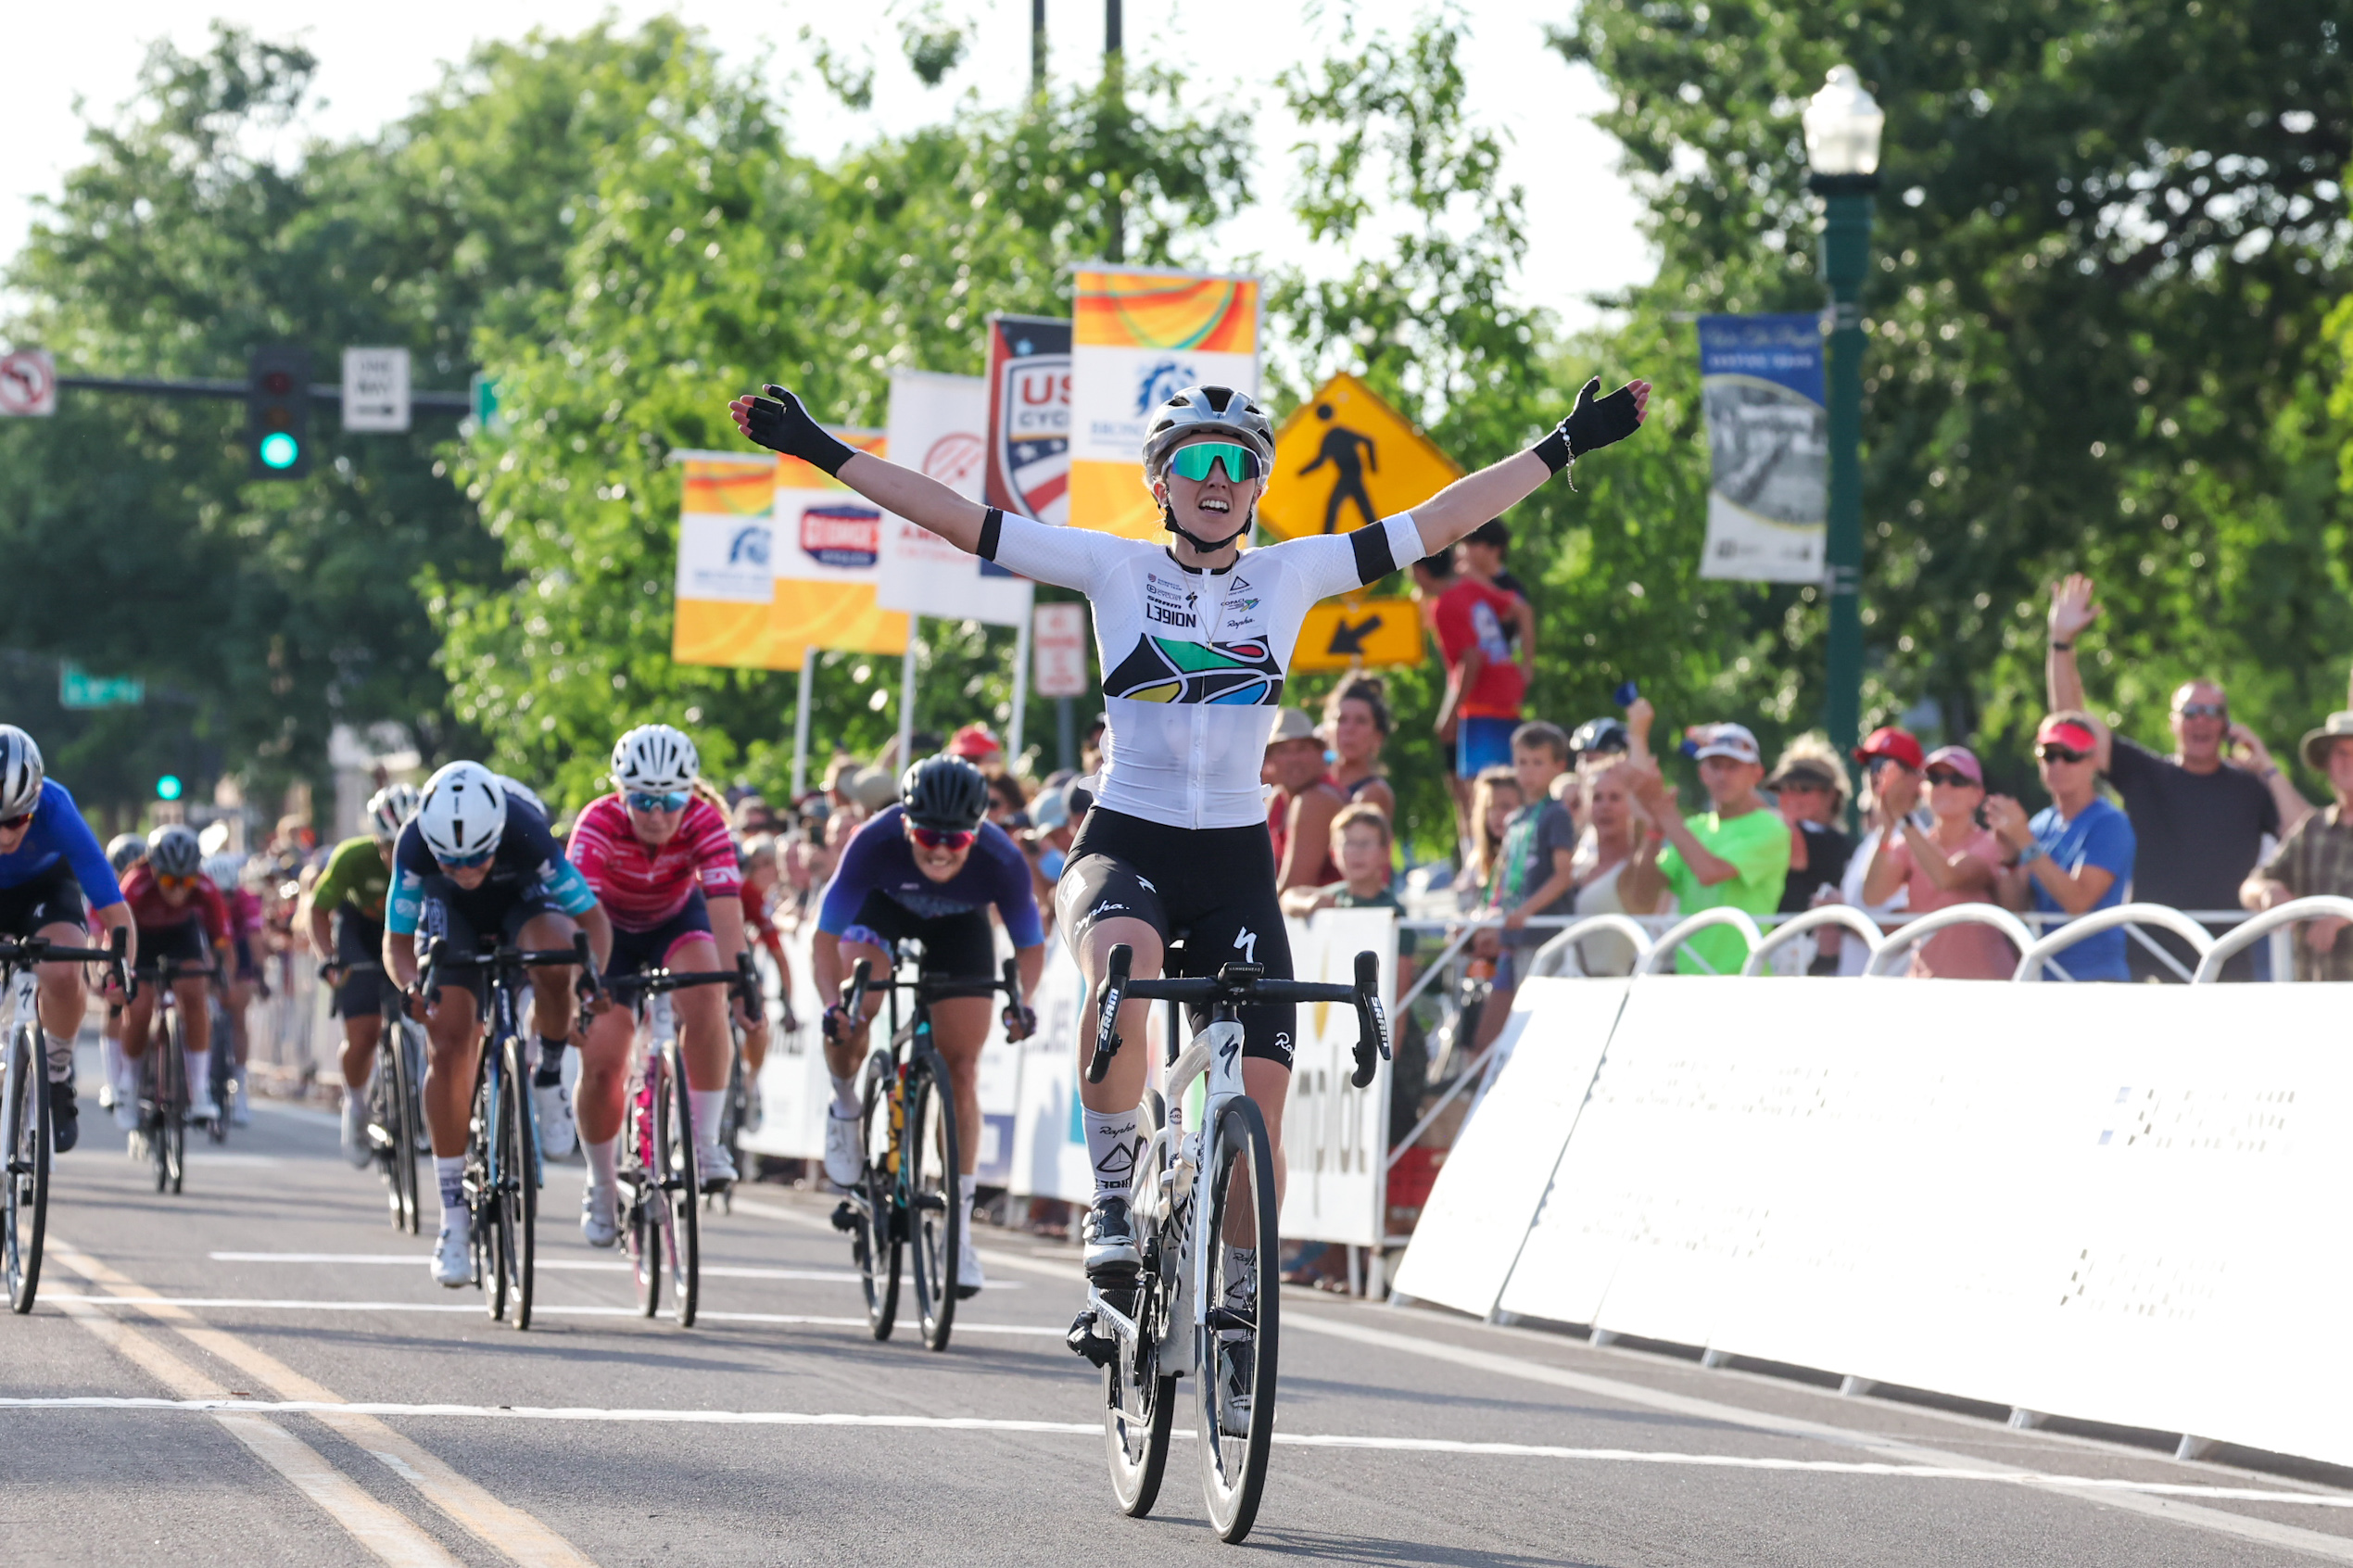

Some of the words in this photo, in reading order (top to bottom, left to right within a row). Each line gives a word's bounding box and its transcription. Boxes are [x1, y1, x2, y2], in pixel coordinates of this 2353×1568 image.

[1146, 602, 1196, 628] L39ION
[1147, 595, 1183, 610] SRAM
[1100, 988, 1120, 1042] SRAM
[1371, 996, 1389, 1047] SRAM
[1095, 1303, 1130, 1338] SPECIALIZED
